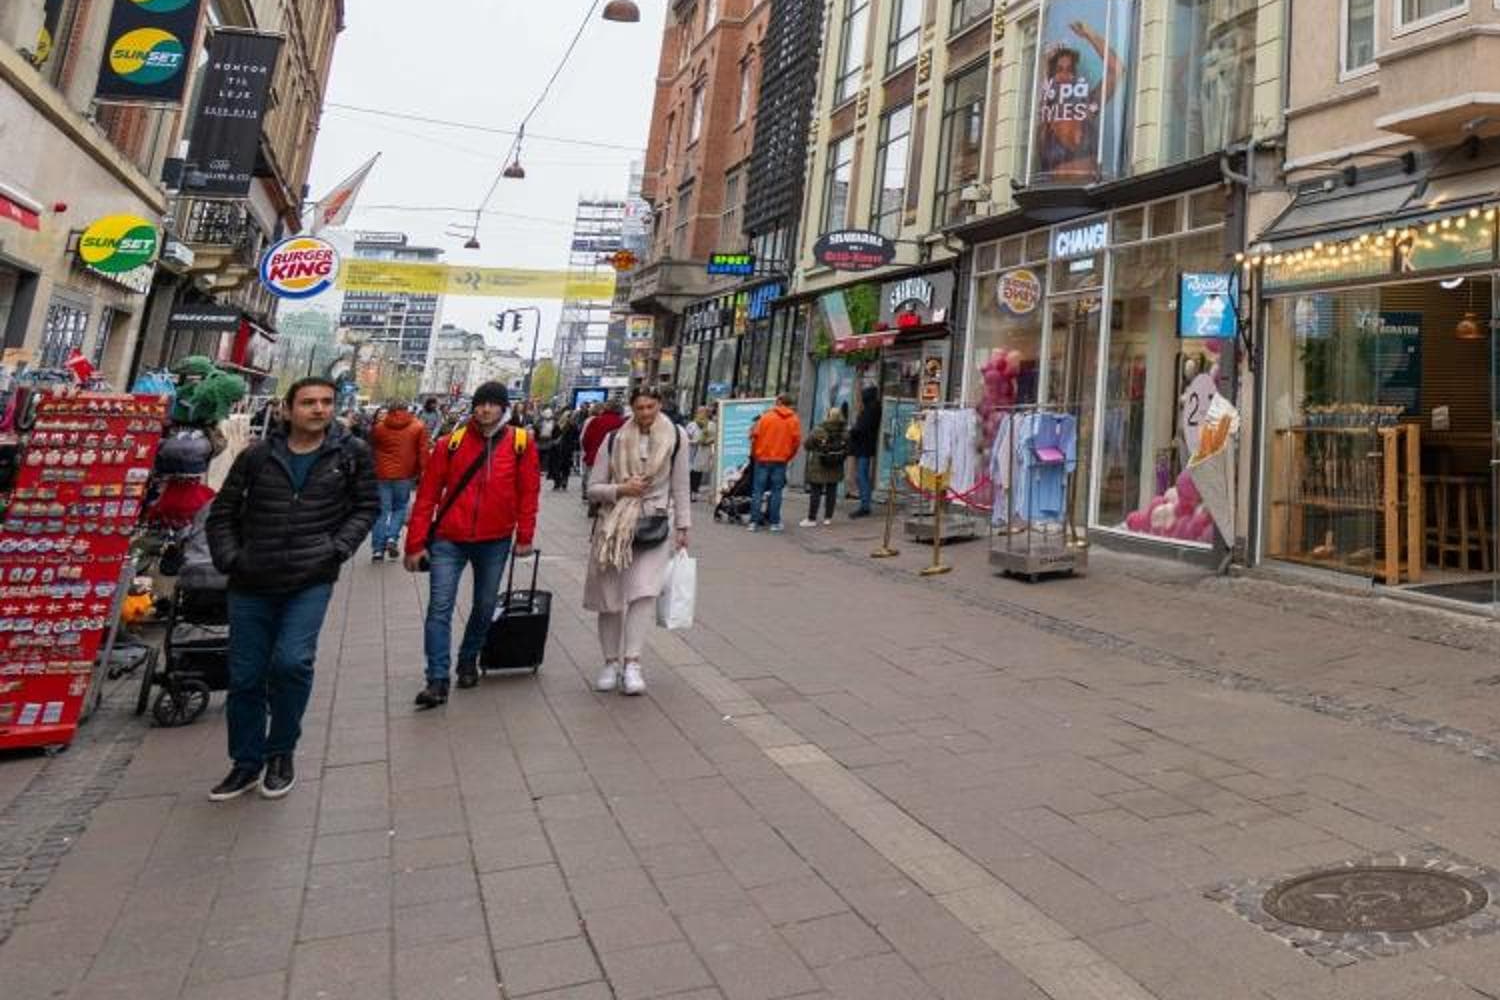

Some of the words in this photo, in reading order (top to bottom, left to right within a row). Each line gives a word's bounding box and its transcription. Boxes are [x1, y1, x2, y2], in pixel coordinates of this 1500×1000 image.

[111, 49, 183, 63] SUNSET
[1059, 77, 1089, 104] på
[82, 236, 155, 249] SUNSET
[271, 249, 333, 266] BURGER
[269, 261, 333, 281] KING
